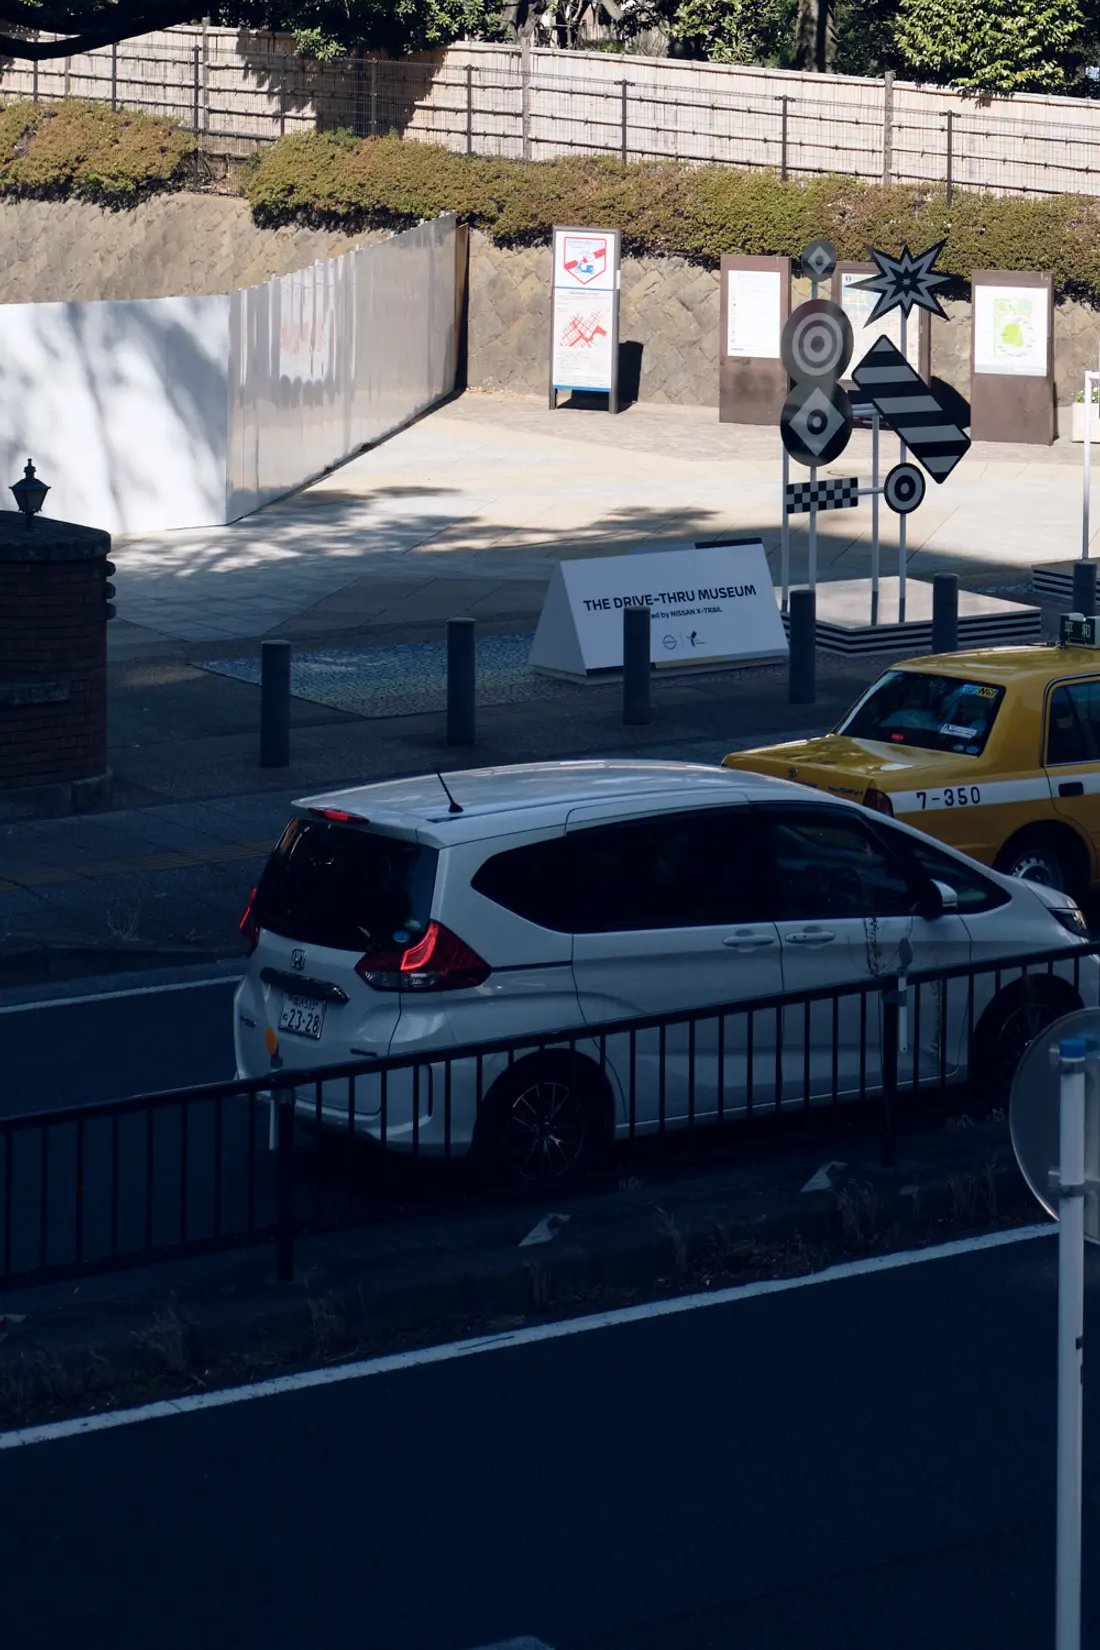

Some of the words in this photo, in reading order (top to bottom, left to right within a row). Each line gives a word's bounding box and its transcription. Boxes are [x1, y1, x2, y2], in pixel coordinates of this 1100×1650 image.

[583, 597, 611, 612] THE
[614, 589, 696, 609] DRIVE-THRU
[699, 584, 757, 601] MUSEUM
[660, 611, 670, 619] by
[670, 608, 696, 618] NISSAN
[696, 606, 723, 615] X-TRAIL
[916, 786, 981, 810] 7-350
[287, 1008, 320, 1034] 23-28
